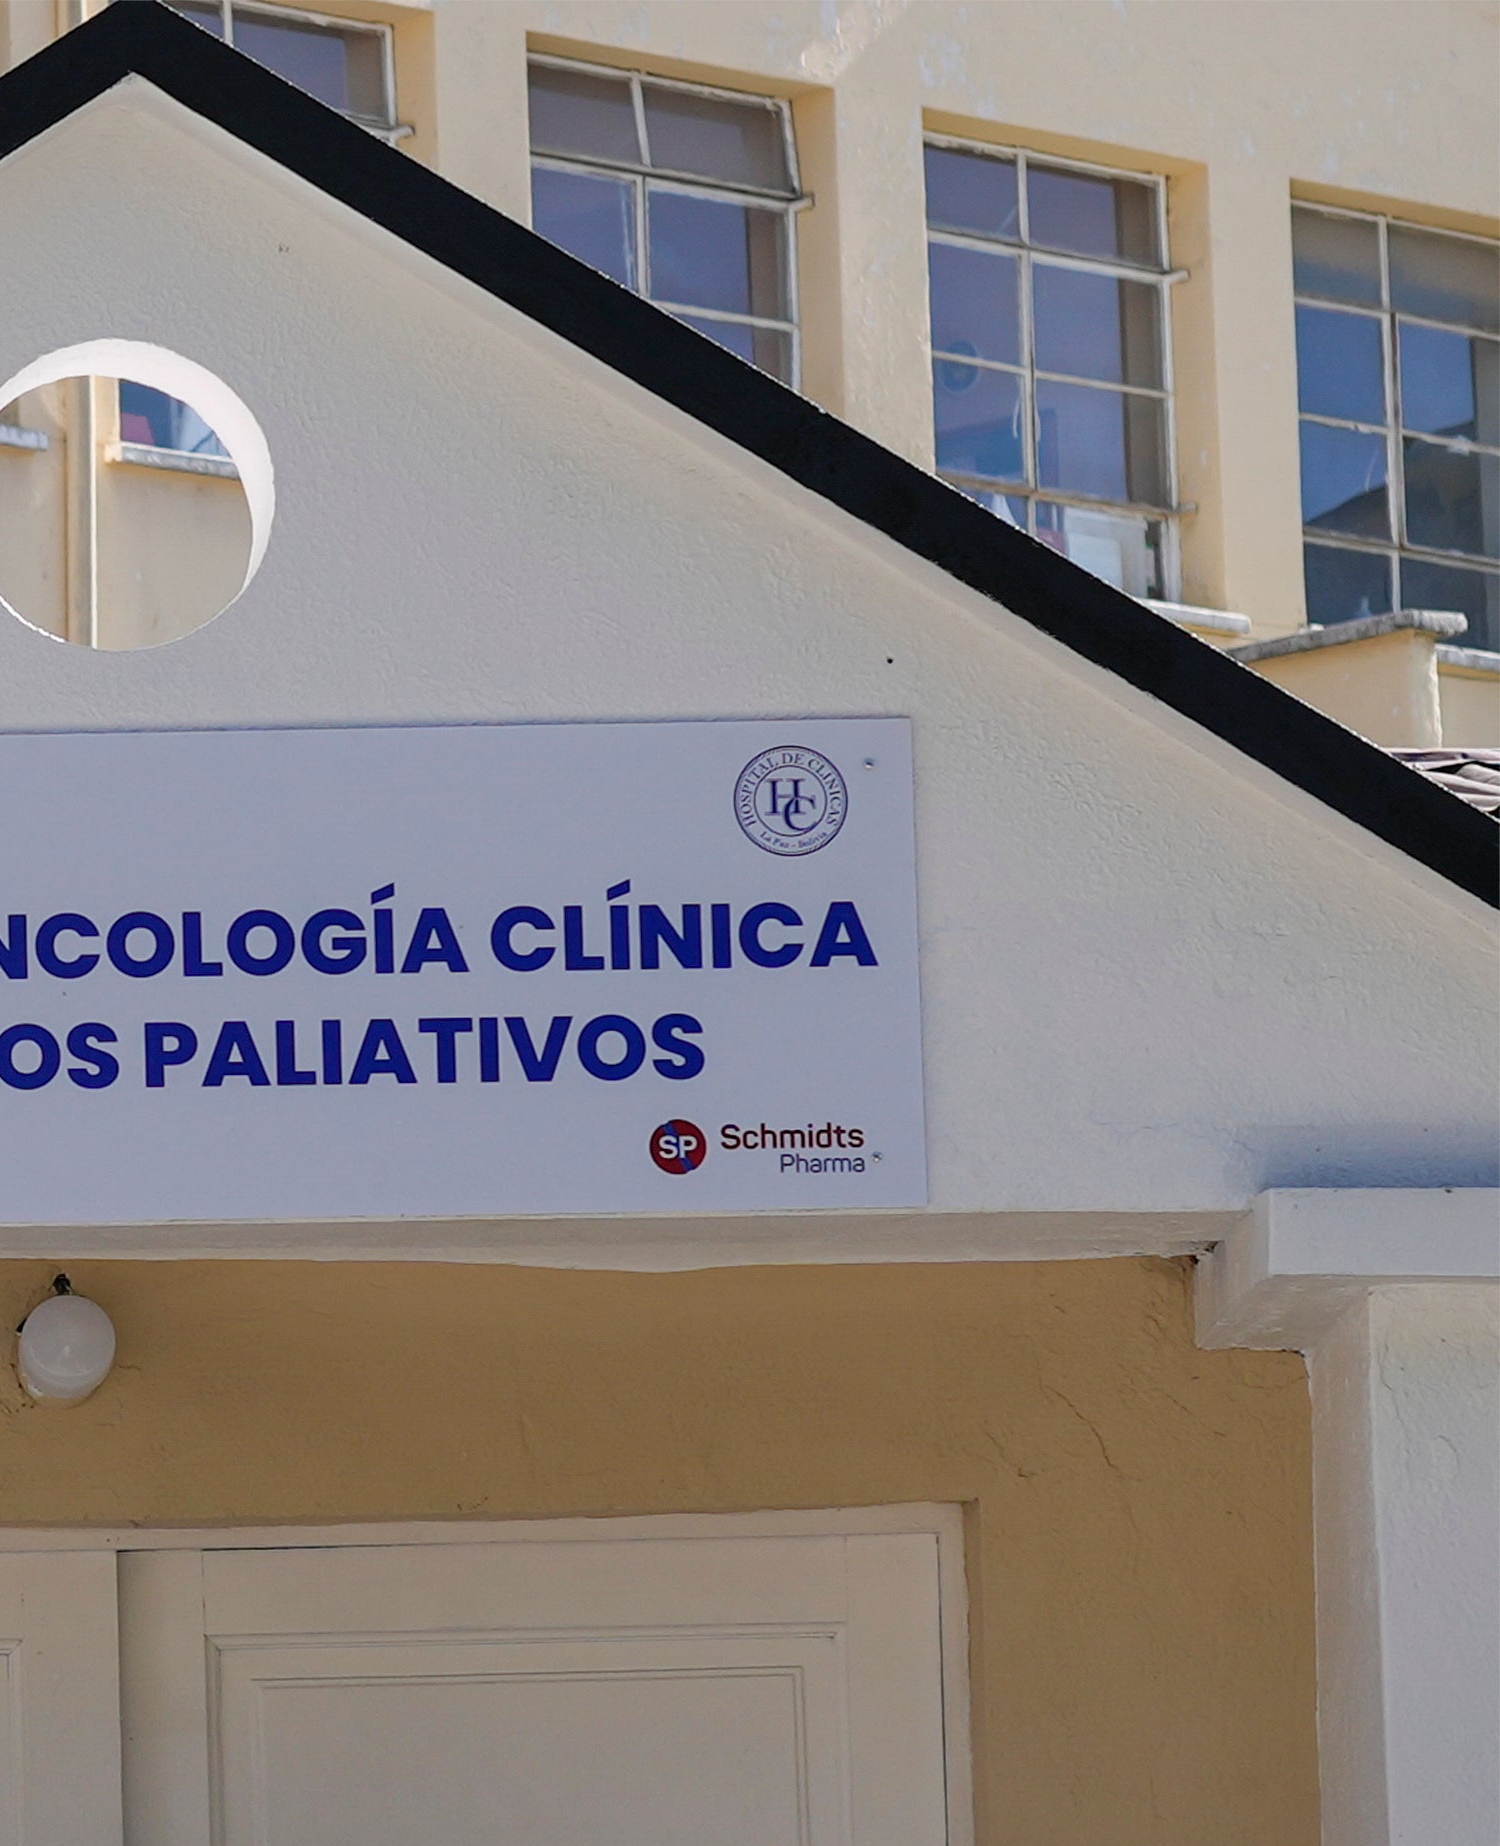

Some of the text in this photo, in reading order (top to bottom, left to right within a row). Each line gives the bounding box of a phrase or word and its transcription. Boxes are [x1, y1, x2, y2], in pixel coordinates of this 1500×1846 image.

[741, 753, 841, 827] HOSPITAL DE CLINICAS
[490, 880, 879, 974] CLÍNICA
[143, 1013, 707, 1089] PALIATIVOS
[658, 1135, 698, 1158] SP
[721, 1122, 864, 1150] Schmidts
[780, 1154, 865, 1173] Pharma
